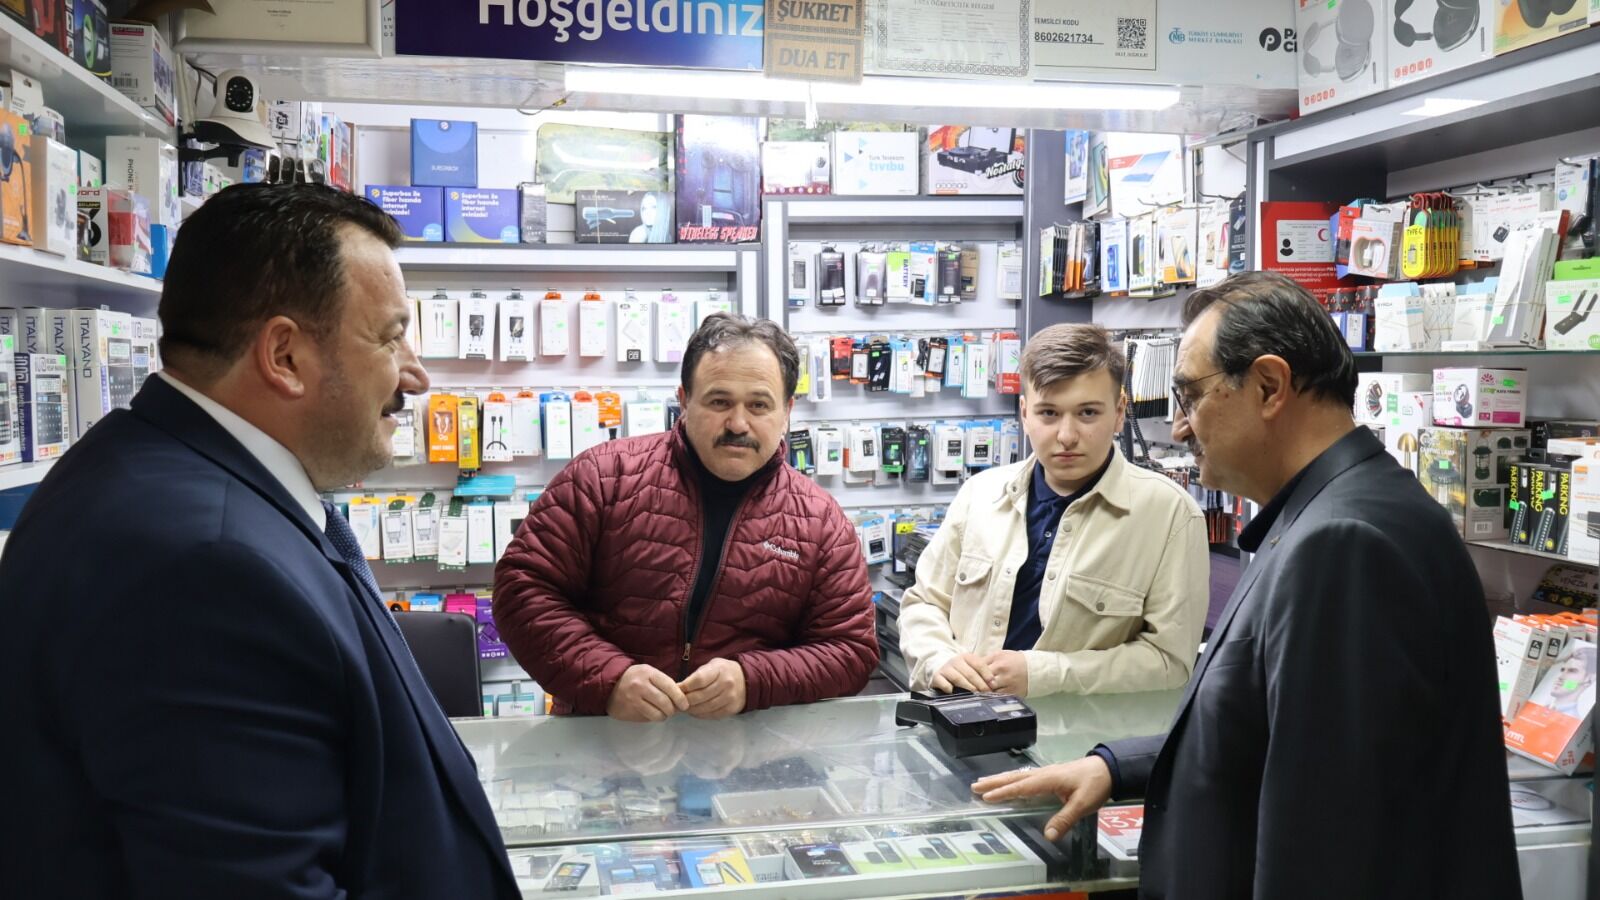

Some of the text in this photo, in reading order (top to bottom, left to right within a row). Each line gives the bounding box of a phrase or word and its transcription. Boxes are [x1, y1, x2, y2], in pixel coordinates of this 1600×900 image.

[478, 0, 764, 42] Hoşgeldiniz
[1034, 31, 1094, 44] 8602621734
[778, 47, 850, 71] DUA ET
[1535, 470, 1544, 512] PARKING
[1559, 472, 1569, 516] PARKING
